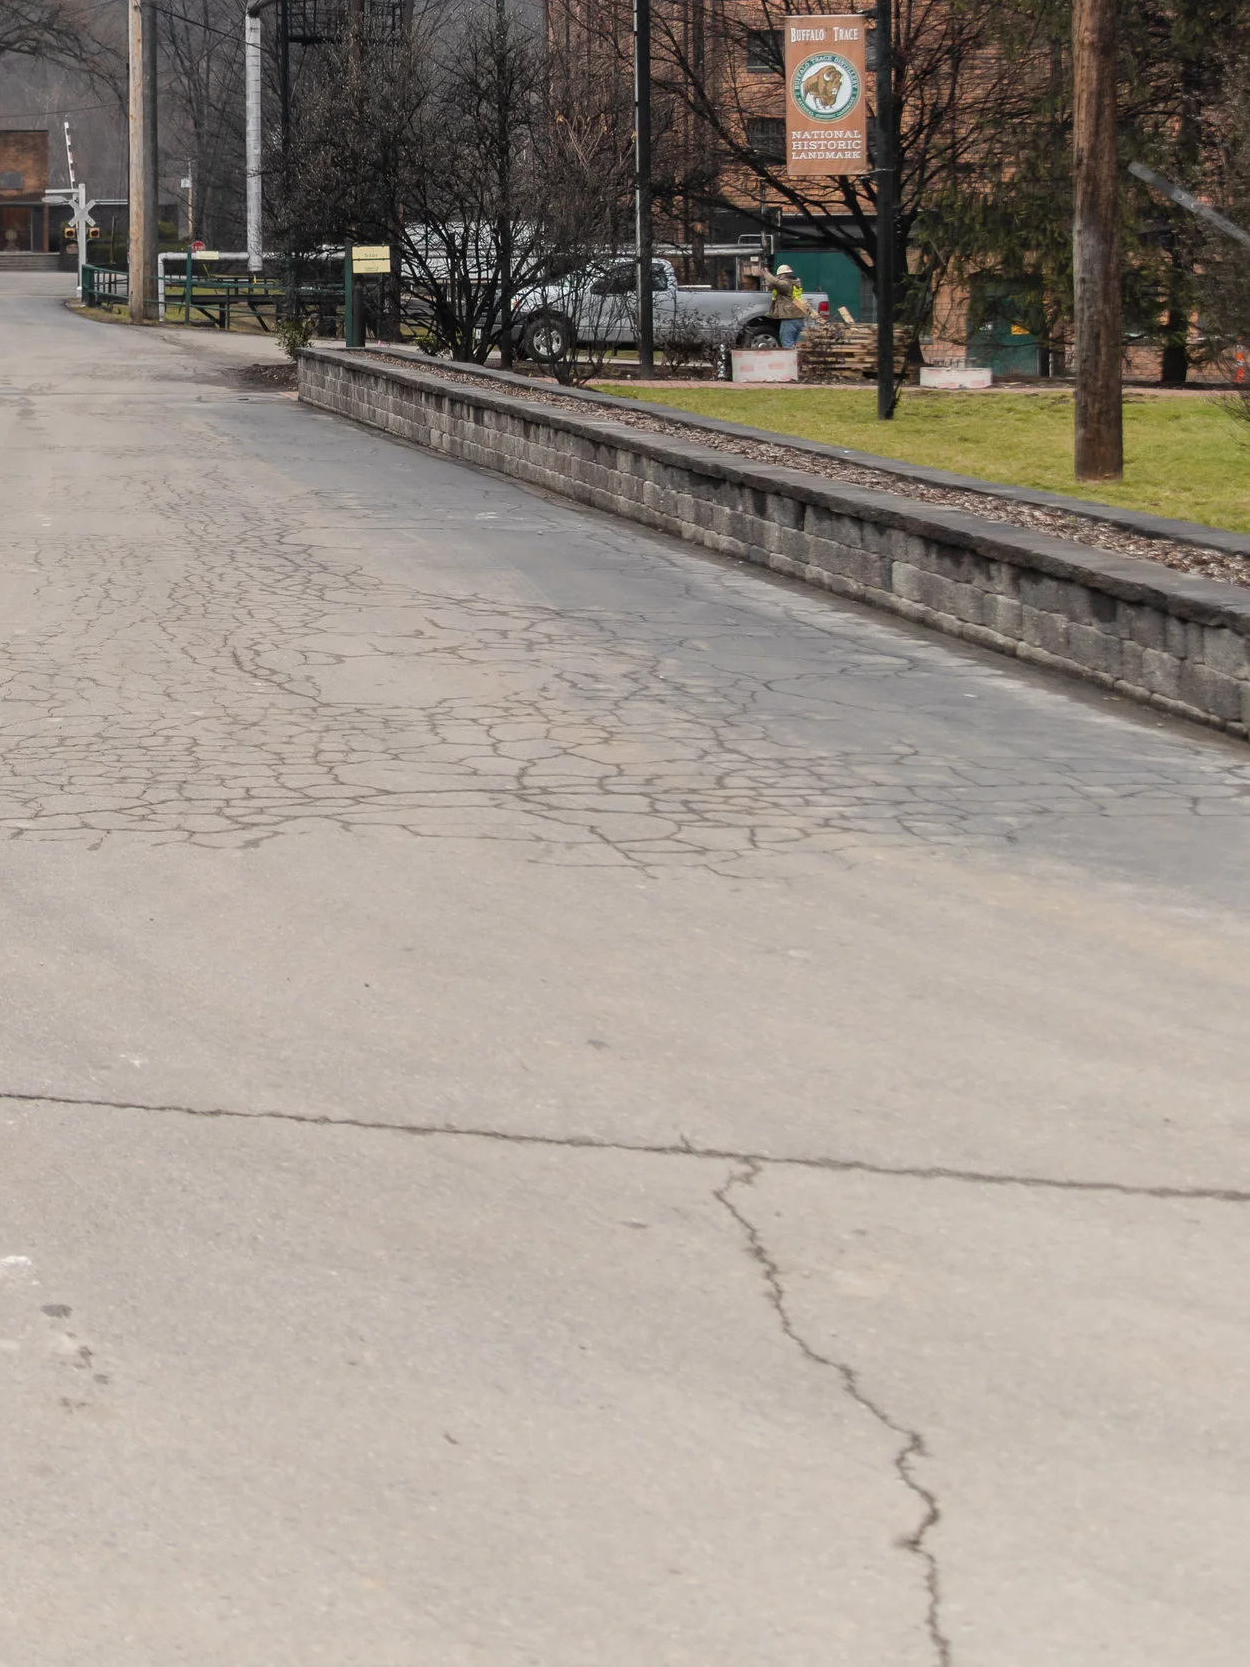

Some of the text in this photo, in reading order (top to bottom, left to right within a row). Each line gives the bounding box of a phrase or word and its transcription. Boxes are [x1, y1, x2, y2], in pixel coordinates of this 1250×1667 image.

[790, 26, 859, 43] BUFFALO TRACE
[791, 130, 862, 140] NATIONAL
[791, 140, 862, 150] HISTORIC
[791, 151, 861, 160] LANDMARK
